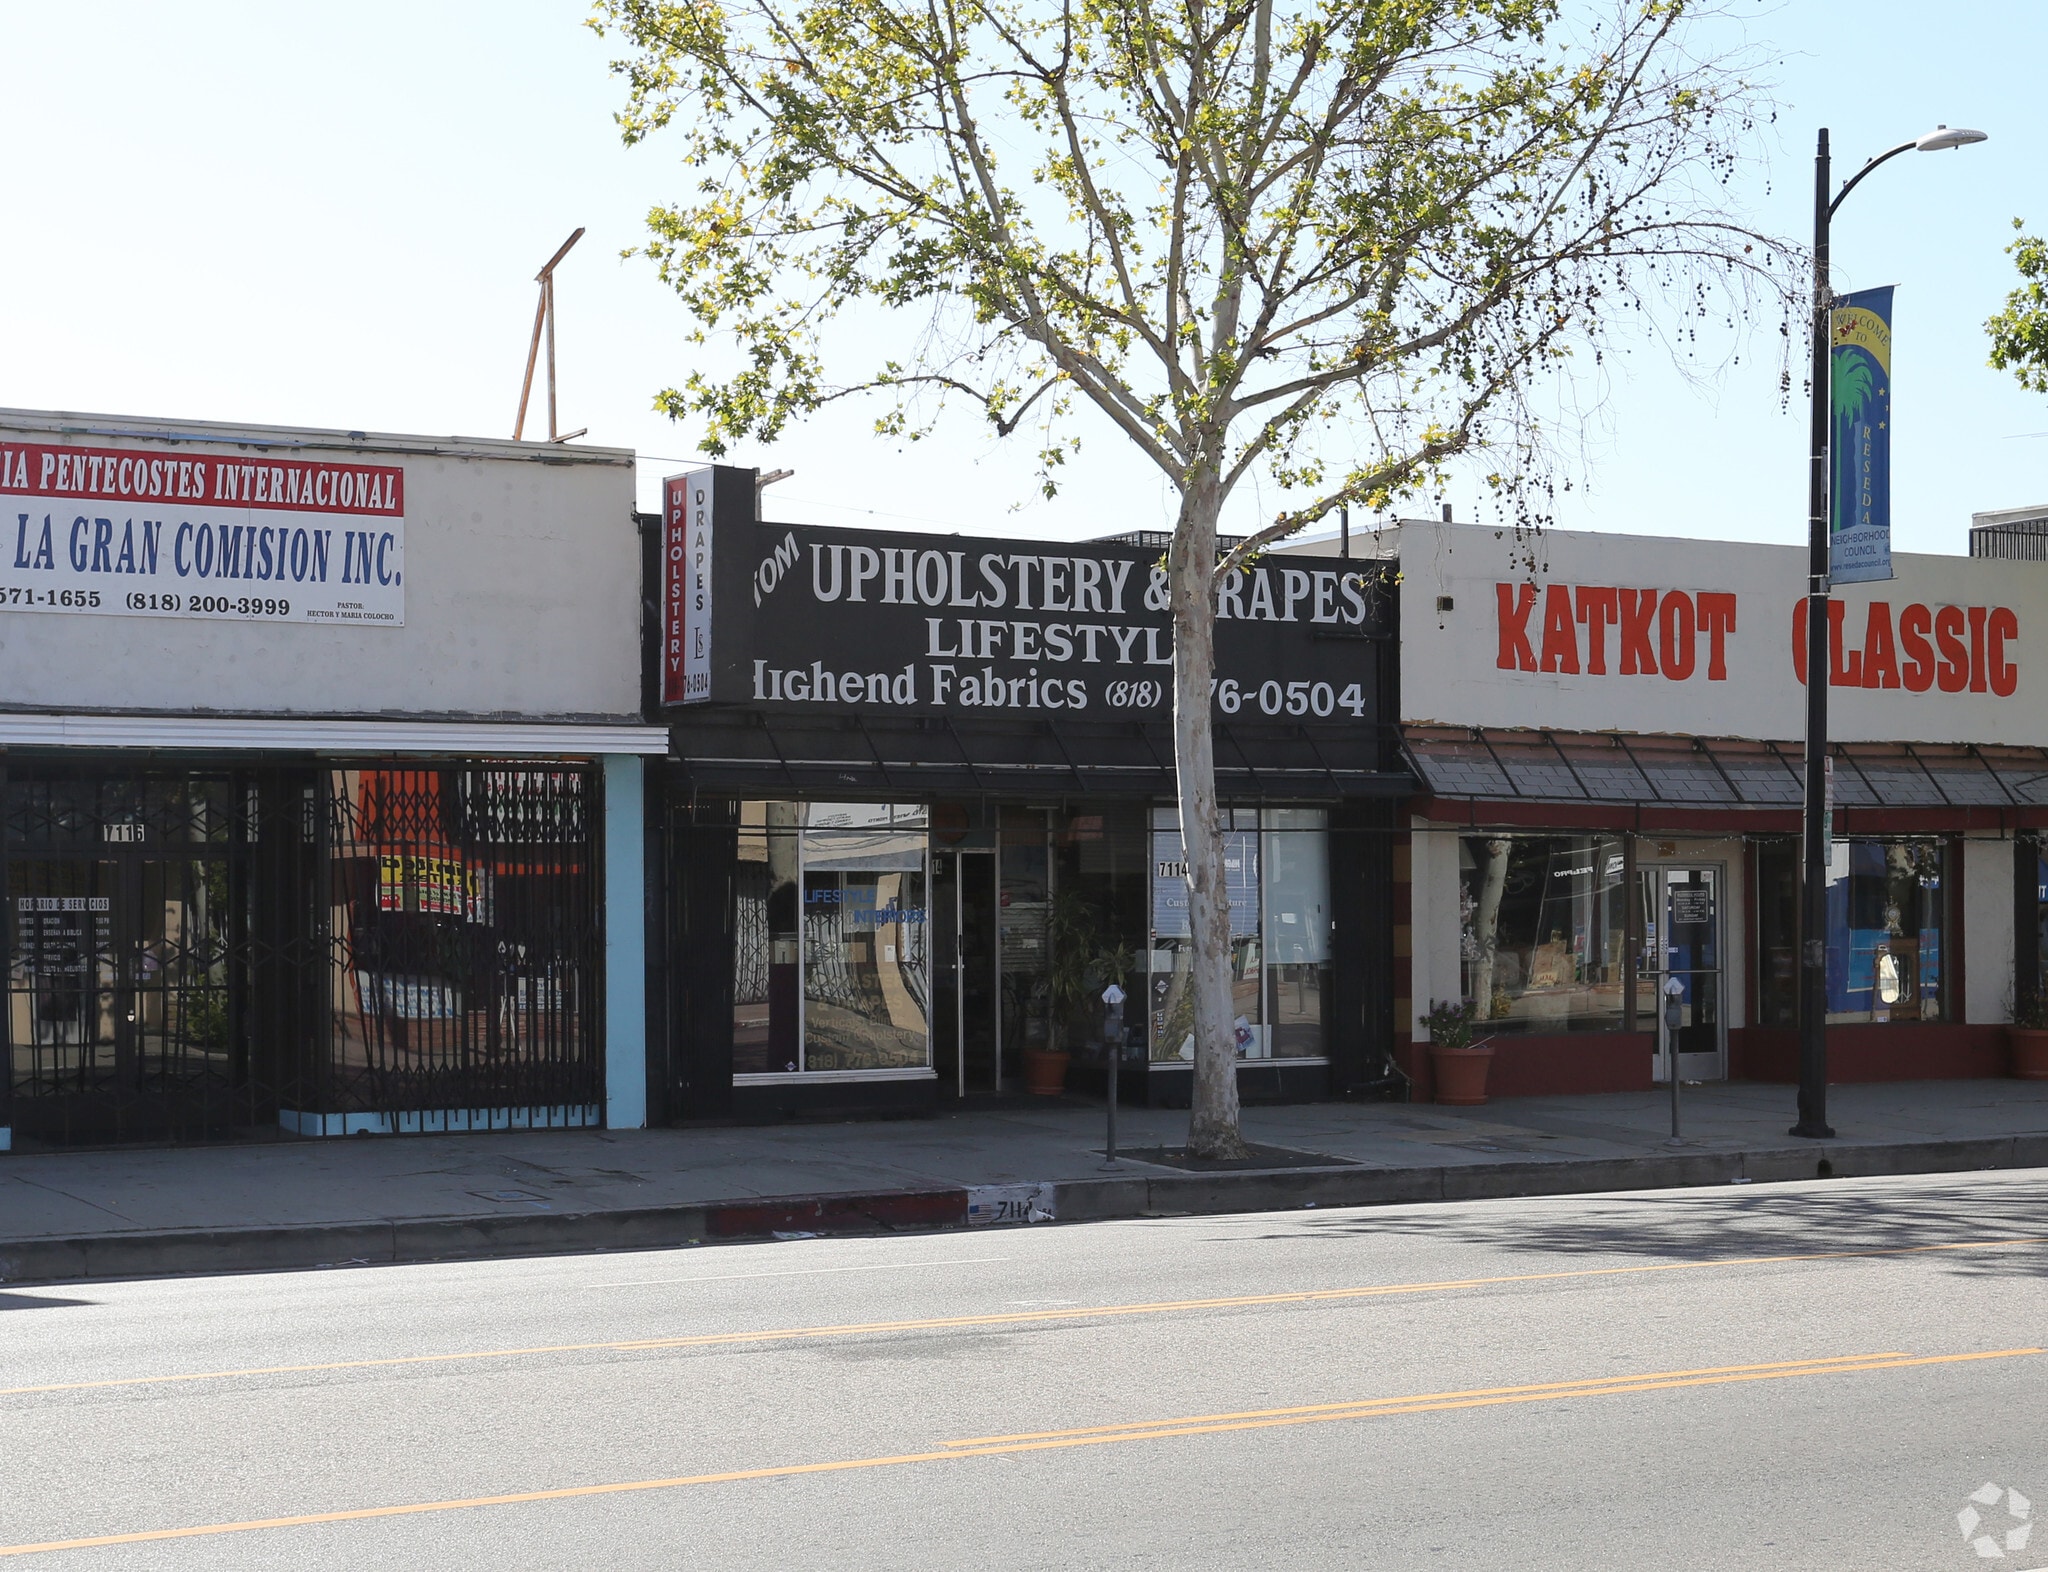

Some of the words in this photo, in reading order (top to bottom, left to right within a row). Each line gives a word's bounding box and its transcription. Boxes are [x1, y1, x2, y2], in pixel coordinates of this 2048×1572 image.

[1855, 331, 1868, 343] TO
[0, 449, 30, 490] IA
[40, 453, 207, 500] PENTECOSTES
[215, 463, 398, 511] INTERNACIONAL
[1861, 425, 1873, 525] RESEDA
[13, 513, 55, 571] LA
[69, 516, 162, 576] GRAN
[174, 521, 333, 583] COMISION
[341, 530, 402, 588] INC.
[694, 489, 706, 611] DRAPES
[1844, 545, 1877, 557] COUNCIL
[126, 592, 183, 612] (818)
[189, 595, 292, 617] 200-3999
[670, 490, 684, 672] UPHOLSTERY
[809, 543, 1136, 615] UPHOLSTERY
[1143, 564, 1172, 612] &
[1215, 566, 1368, 627] RAPES
[307, 610, 334, 618] HECTOR
[341, 611, 362, 619] MARIA
[363, 612, 394, 620] COLOCHO
[1497, 584, 1738, 682] KATKOT
[926, 617, 1175, 666] LIFESTYL
[929, 664, 1090, 711] Fabrics
[1105, 680, 1163, 708] (818)
[1159, 862, 1188, 877] 7114
[804, 889, 876, 904] LIFESTYLE
[854, 909, 927, 924] INTERIORS
